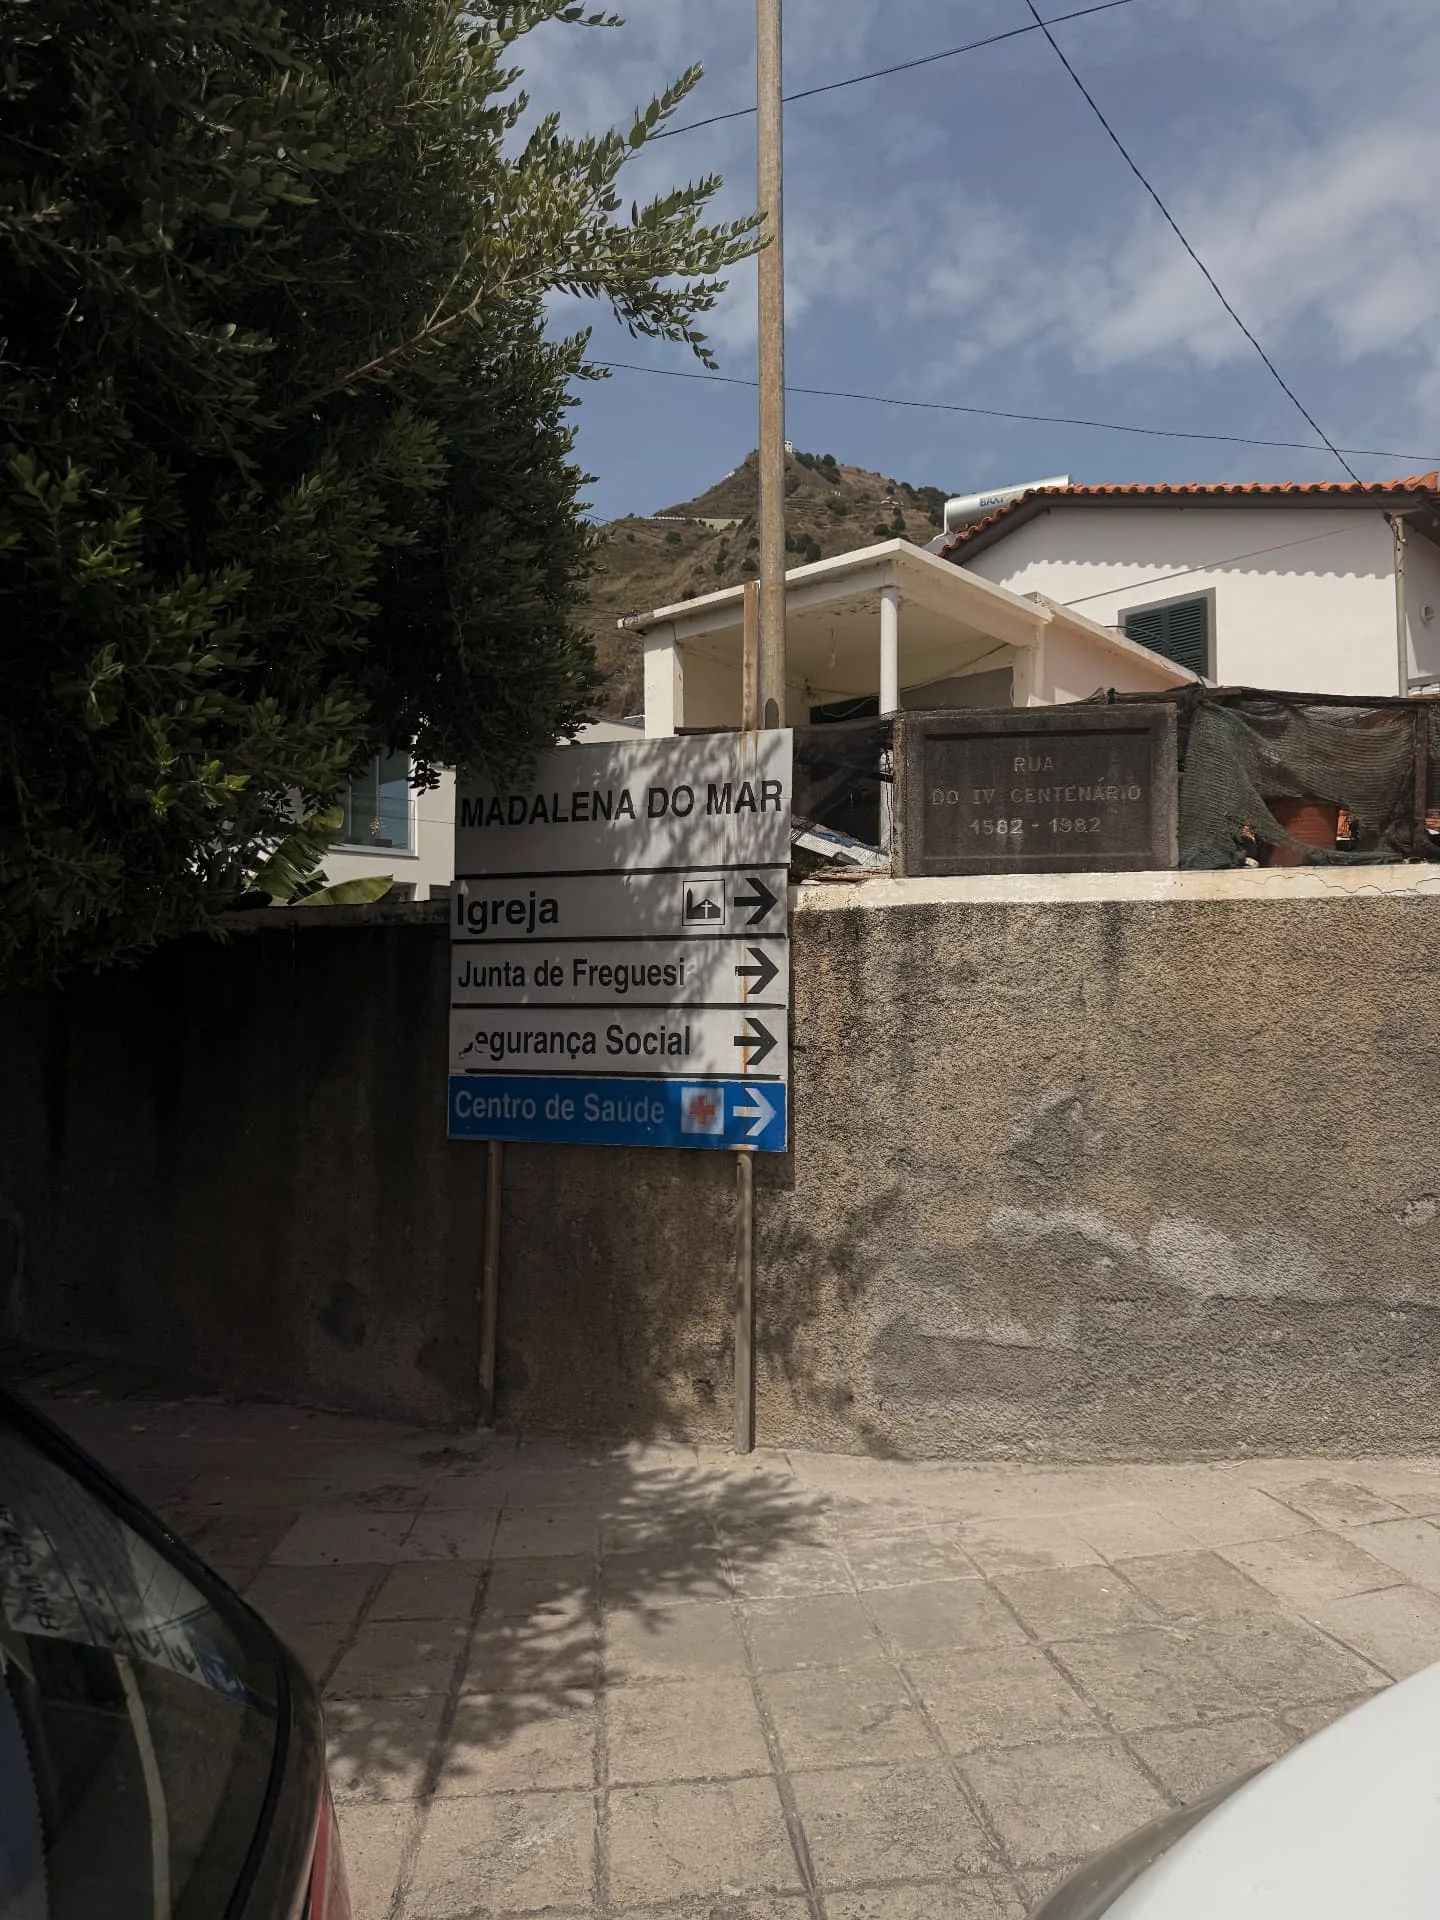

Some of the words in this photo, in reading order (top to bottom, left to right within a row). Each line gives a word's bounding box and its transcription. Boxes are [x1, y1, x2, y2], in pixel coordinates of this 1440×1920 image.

[1013, 756, 1056, 773] RUA
[461, 788, 635, 828] MADALENA
[647, 784, 695, 818] DO
[706, 779, 783, 815] MAR
[931, 788, 959, 805] DO
[973, 788, 996, 805] IV
[1010, 777, 1142, 804] CENTENÁRIO
[1048, 817, 1102, 834] 1982
[457, 889, 559, 935] Igreja
[458, 960, 526, 988] Junta
[534, 959, 564, 987] de
[605, 1025, 691, 1056] Social
[454, 1090, 537, 1119] Centro
[544, 1091, 575, 1121] de
[584, 1093, 665, 1124] Saúde
